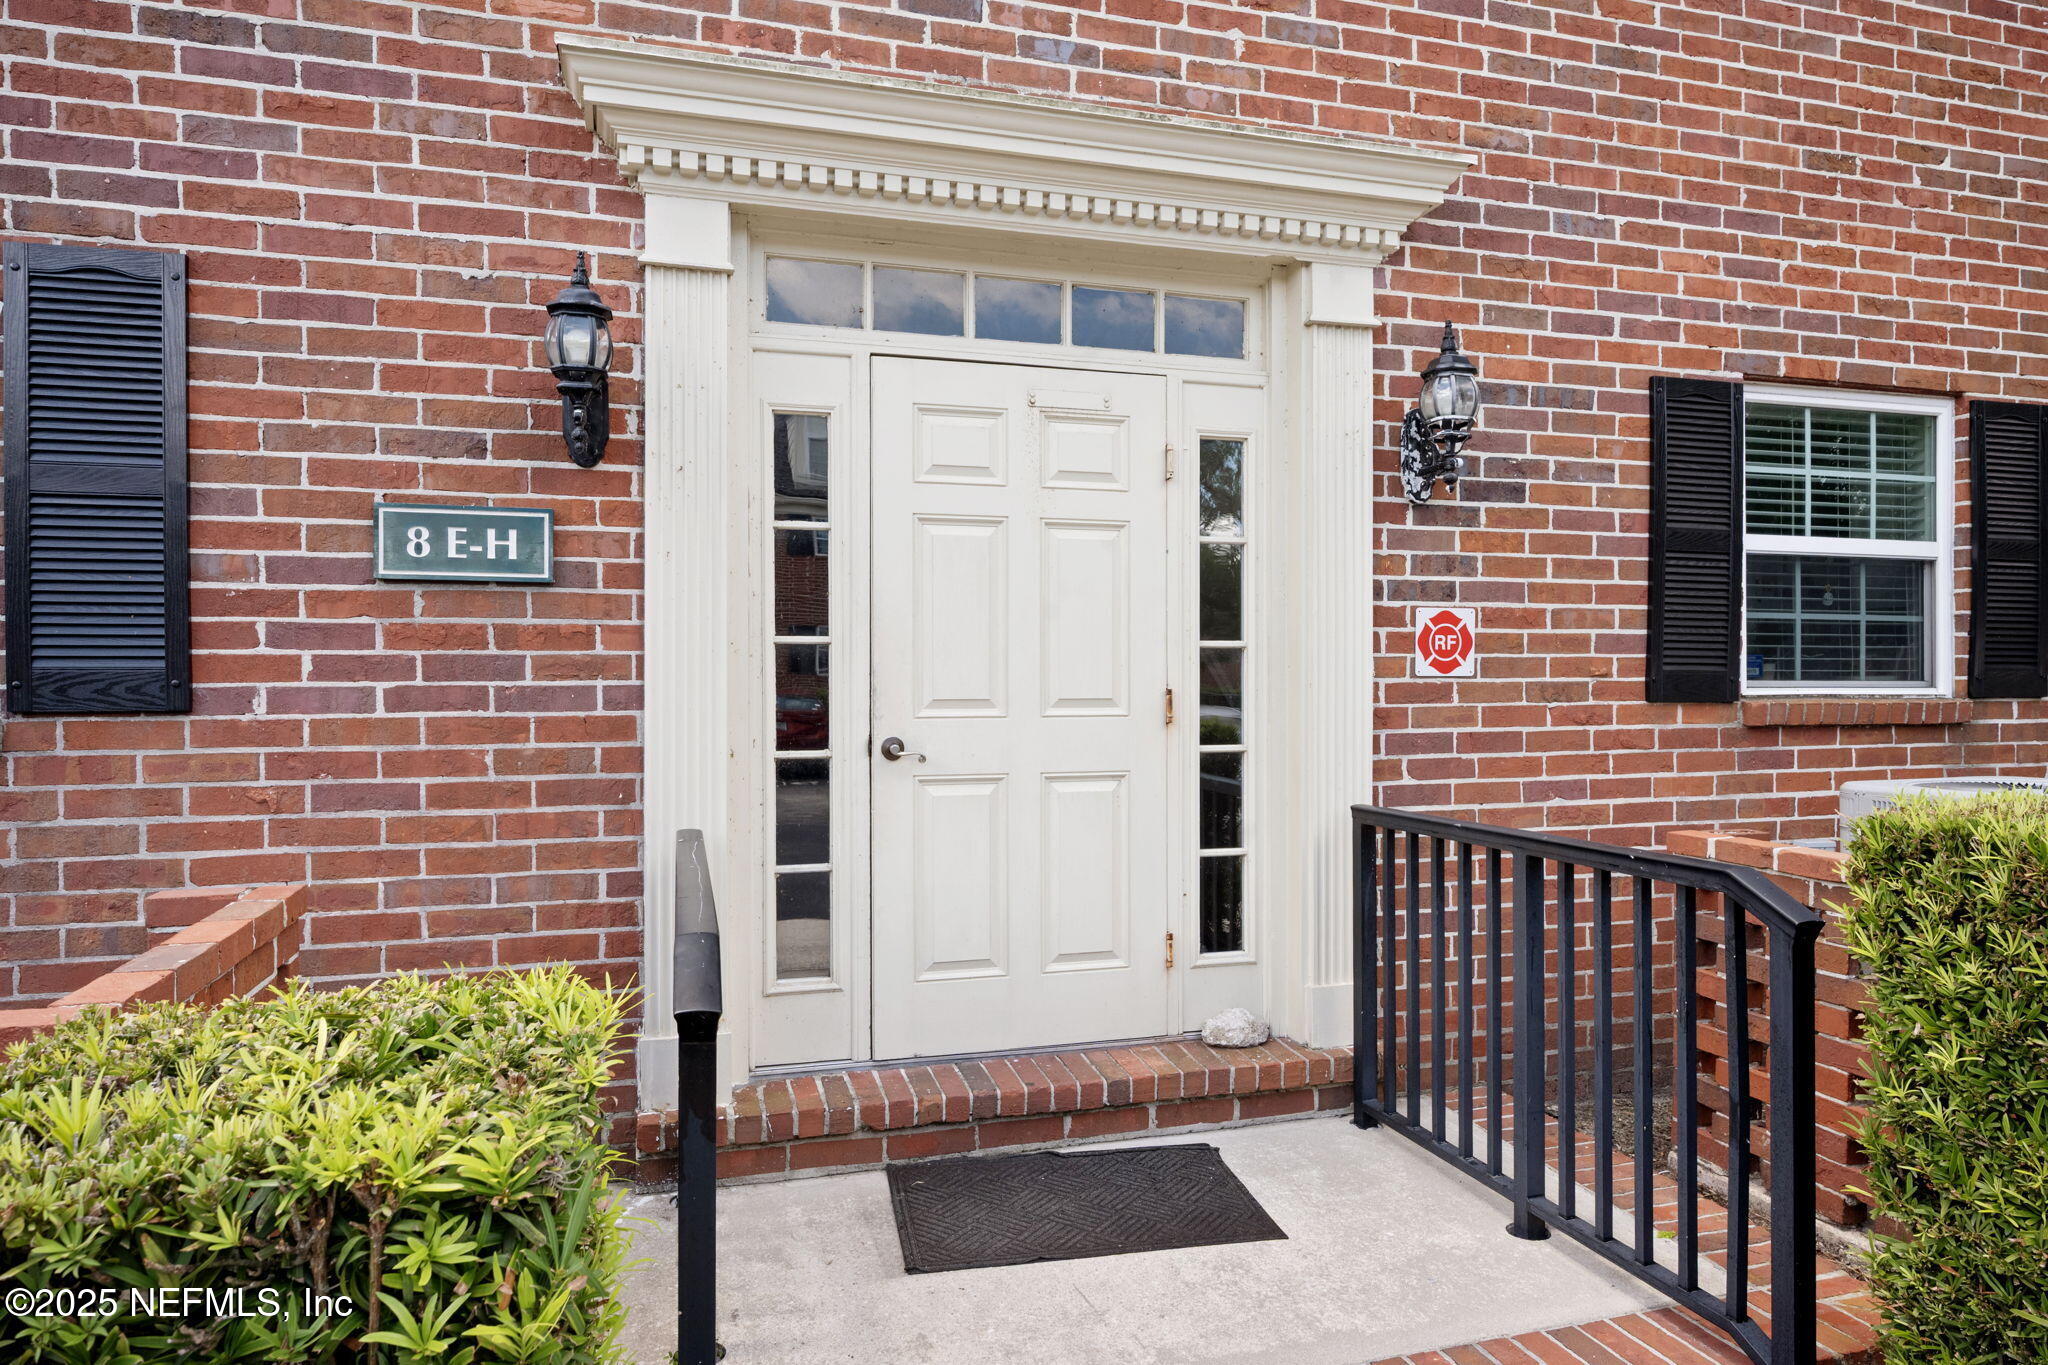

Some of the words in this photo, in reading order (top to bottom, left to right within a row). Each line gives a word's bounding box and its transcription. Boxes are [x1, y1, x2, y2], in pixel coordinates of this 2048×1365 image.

[406, 526, 431, 558] 8
[447, 526, 518, 560] E-H
[1434, 634, 1457, 651] RF
